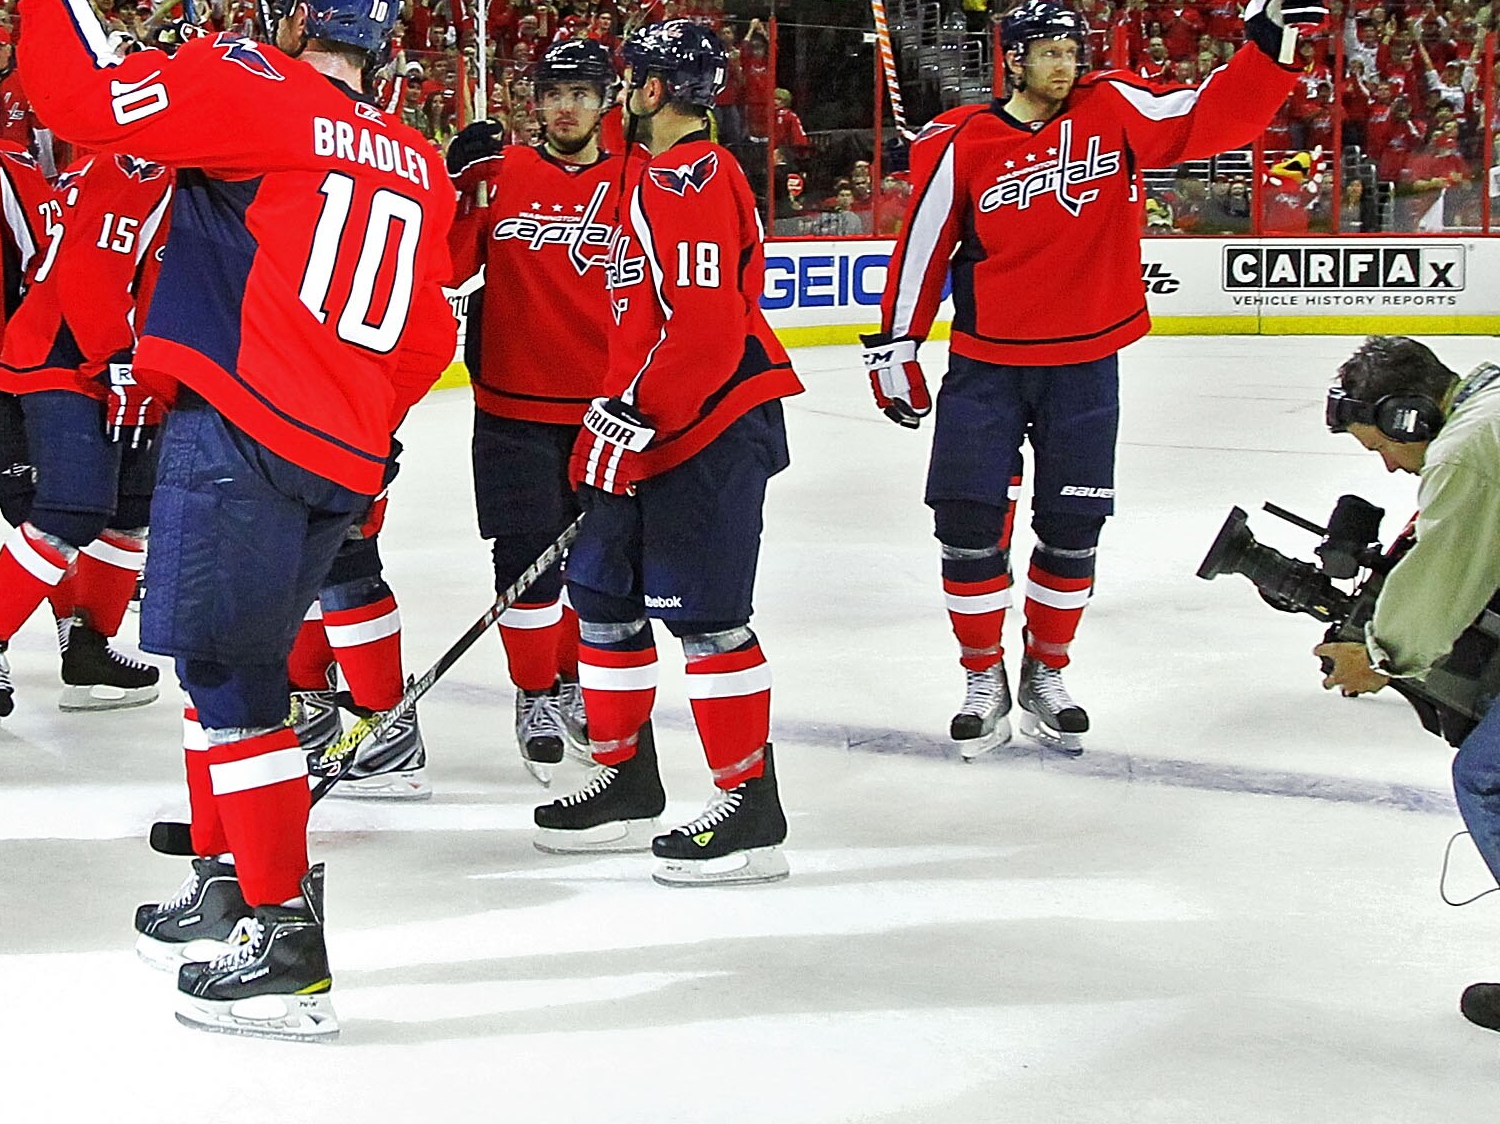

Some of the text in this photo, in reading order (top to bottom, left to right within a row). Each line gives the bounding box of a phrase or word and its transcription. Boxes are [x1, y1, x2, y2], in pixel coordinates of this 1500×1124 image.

[111, 71, 170, 125] 10
[313, 116, 430, 190] BRADLEY
[979, 120, 1121, 217] capitals
[97, 212, 140, 254] 15
[299, 171, 424, 354] 10
[677, 241, 721, 288] 18
[759, 254, 894, 311] GEIC
[1231, 252, 1456, 288] CARFAX
[1233, 295, 1457, 306] VEHICLE HISTORY REPORTS
